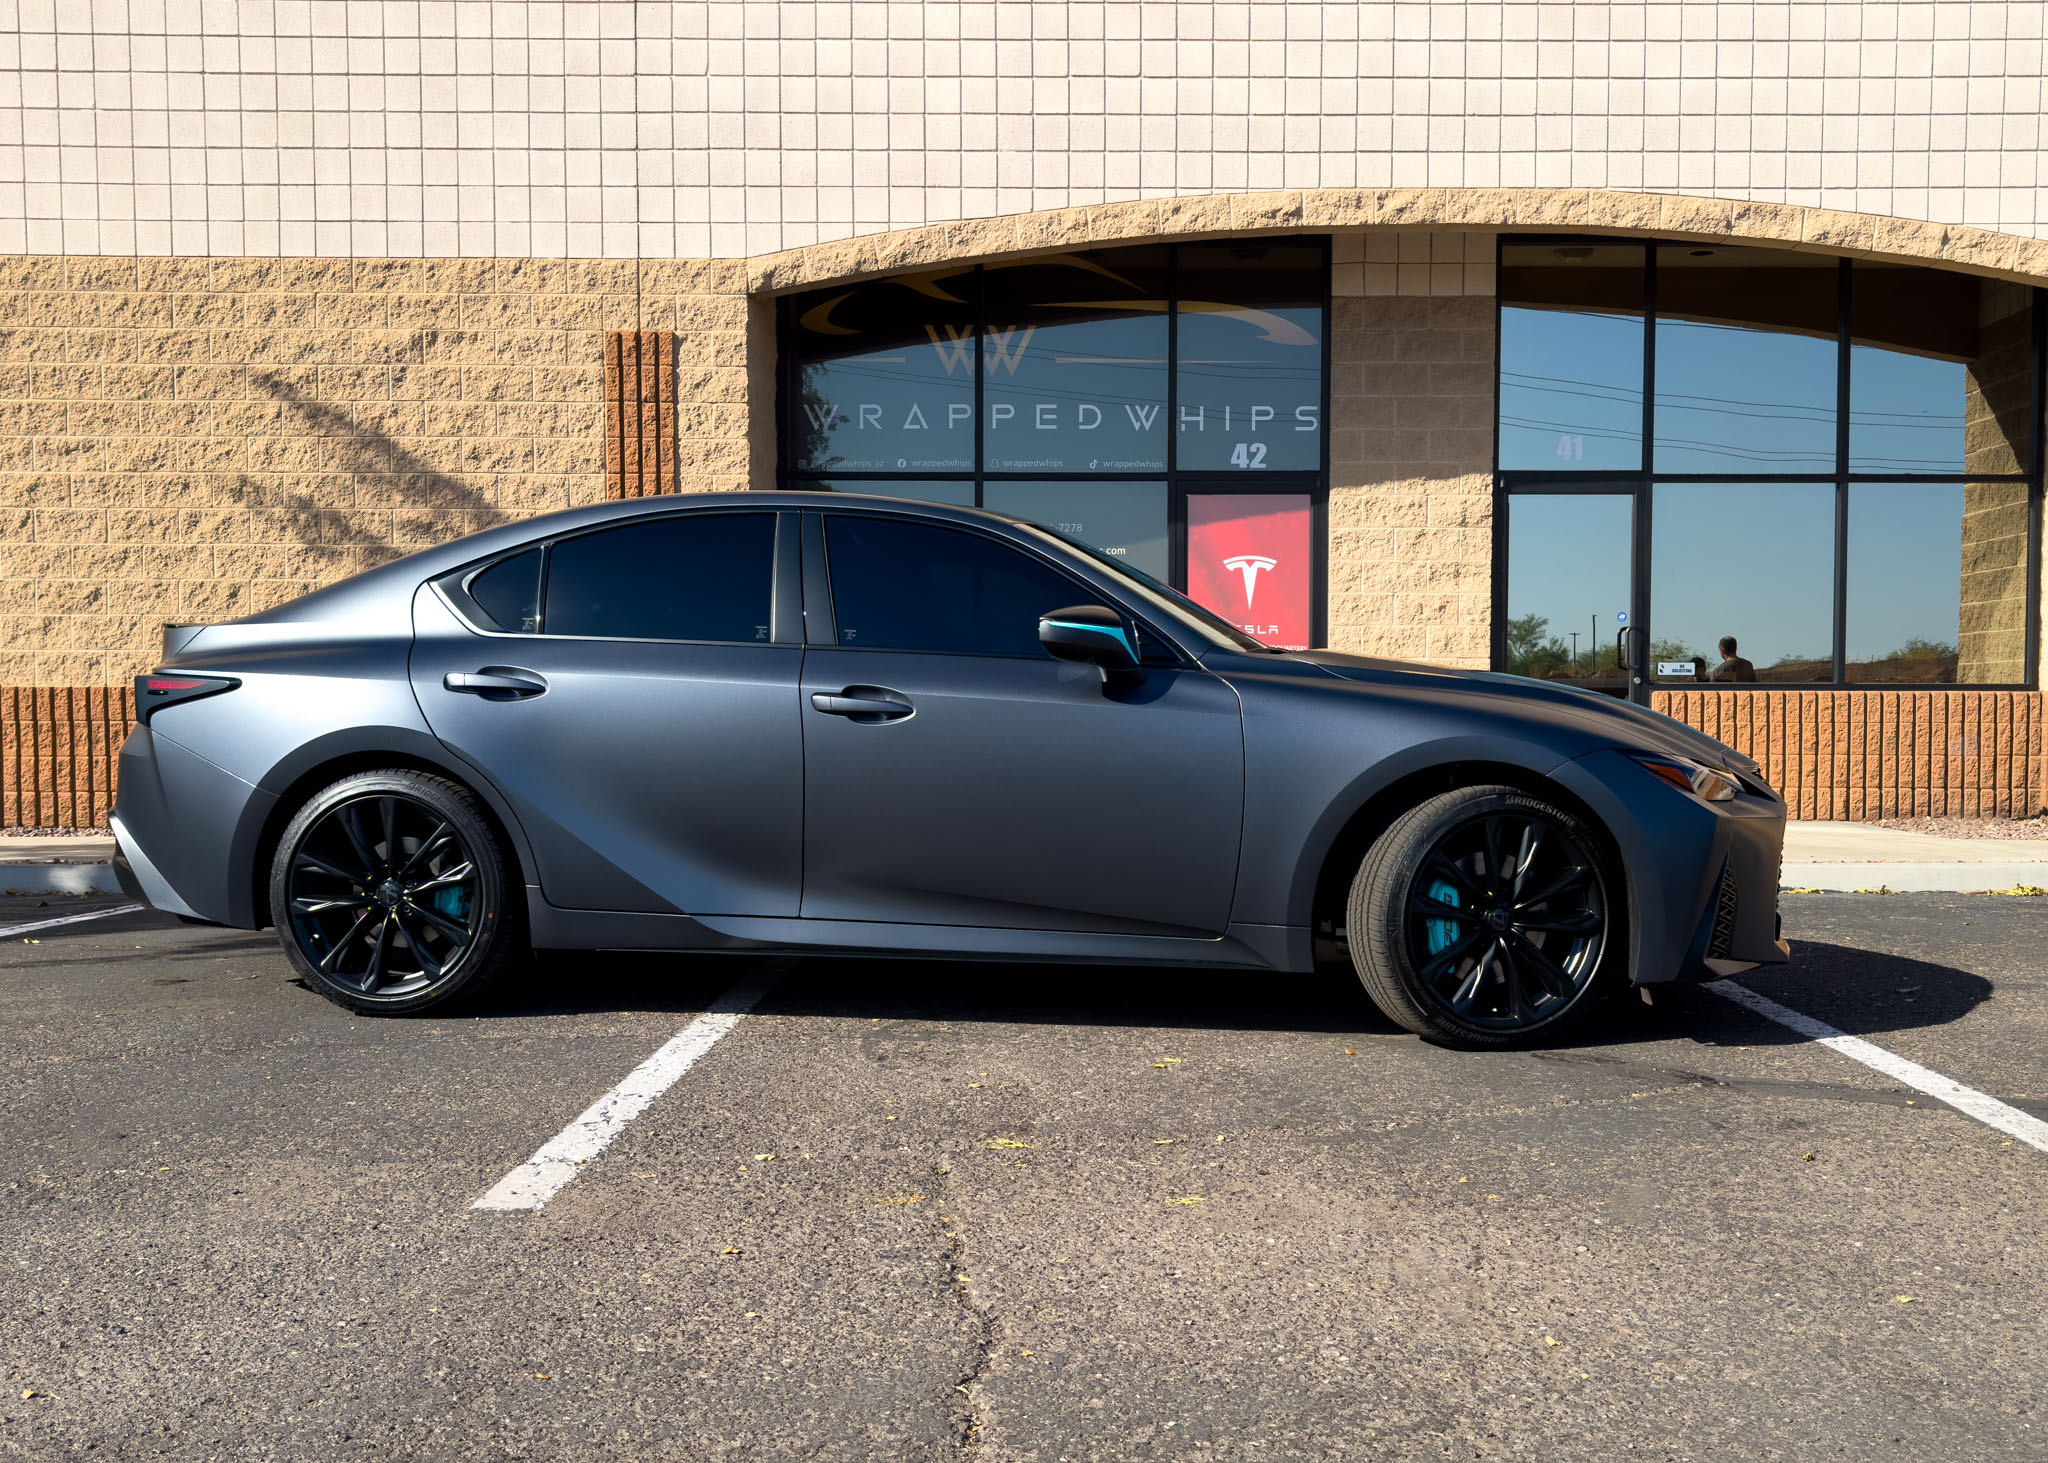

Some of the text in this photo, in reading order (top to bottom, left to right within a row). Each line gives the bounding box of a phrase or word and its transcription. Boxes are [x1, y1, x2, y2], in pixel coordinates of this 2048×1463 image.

[1557, 435, 1583, 460] 41
[1230, 442, 1267, 469] 42
[911, 457, 971, 469] wrappedwhips
[1002, 457, 1063, 469] wrappedwhips
[1103, 458, 1164, 469] wrappedwhips
[1236, 624, 1279, 635] SLA
[1504, 794, 1577, 829] BRIDGESTONE
